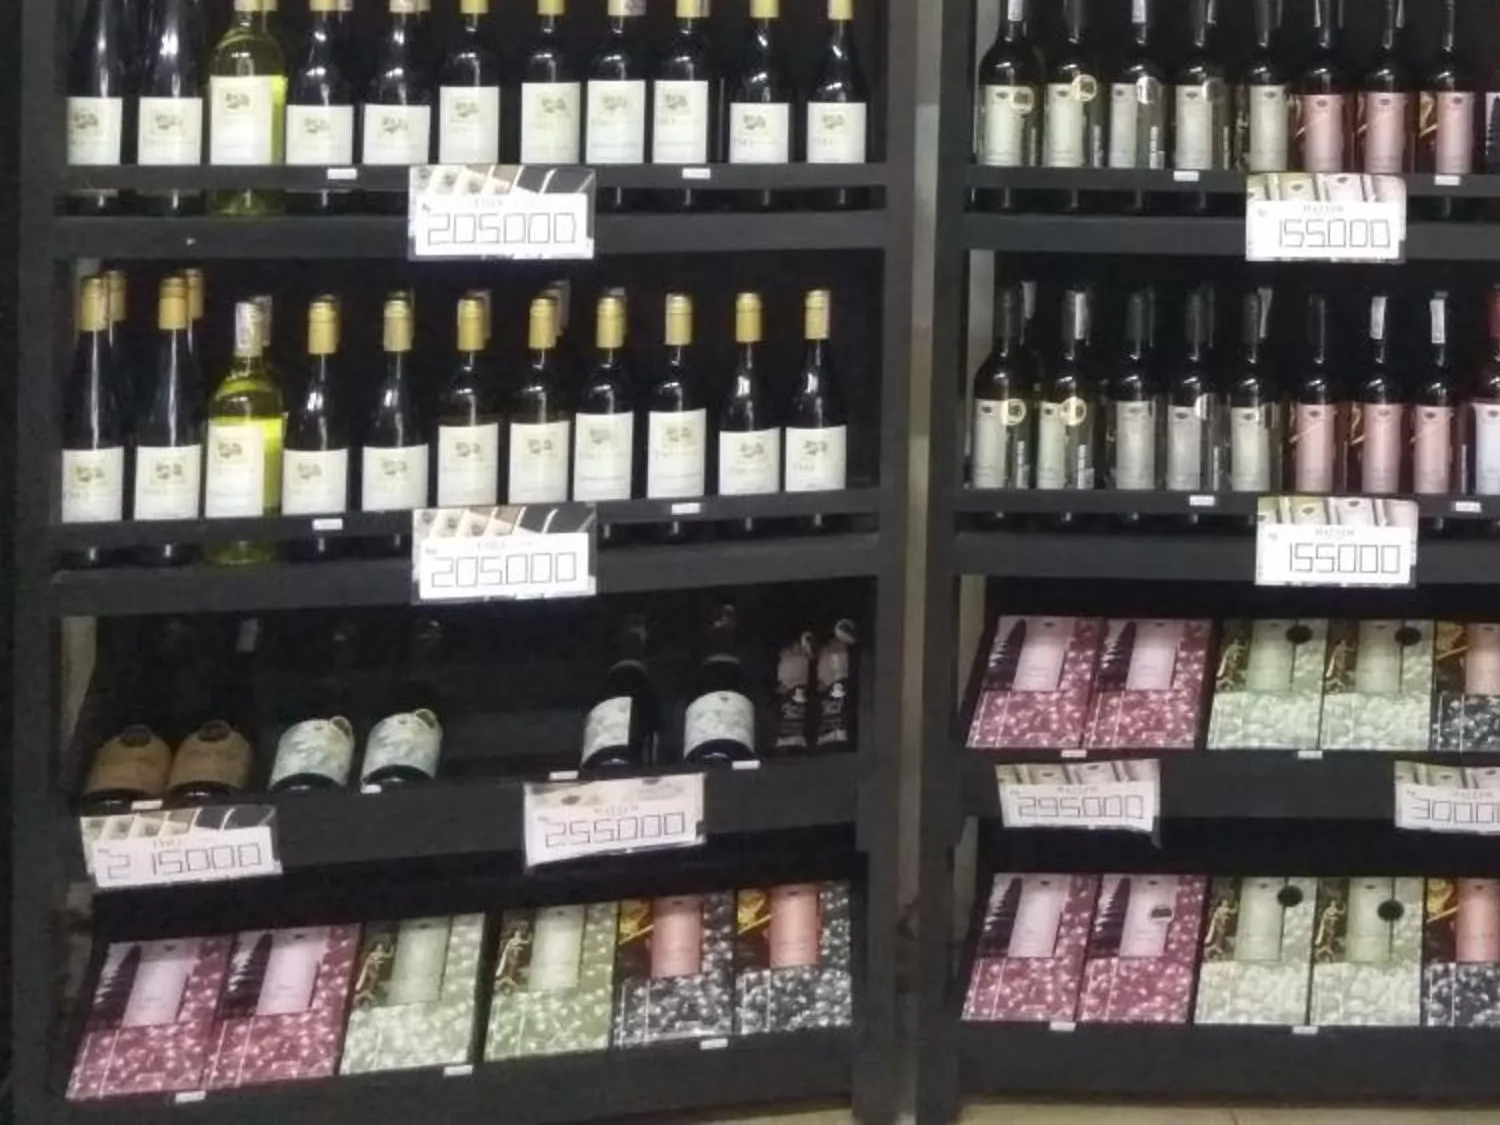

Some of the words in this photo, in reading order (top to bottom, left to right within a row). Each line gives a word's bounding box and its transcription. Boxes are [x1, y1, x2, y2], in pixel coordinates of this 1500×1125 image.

[427, 212, 576, 246] 205000
[1279, 218, 1391, 248] 155000
[431, 551, 577, 588] 205000
[1289, 542, 1401, 574] 155000
[1017, 794, 1144, 820] 295000
[545, 810, 685, 849] 255000
